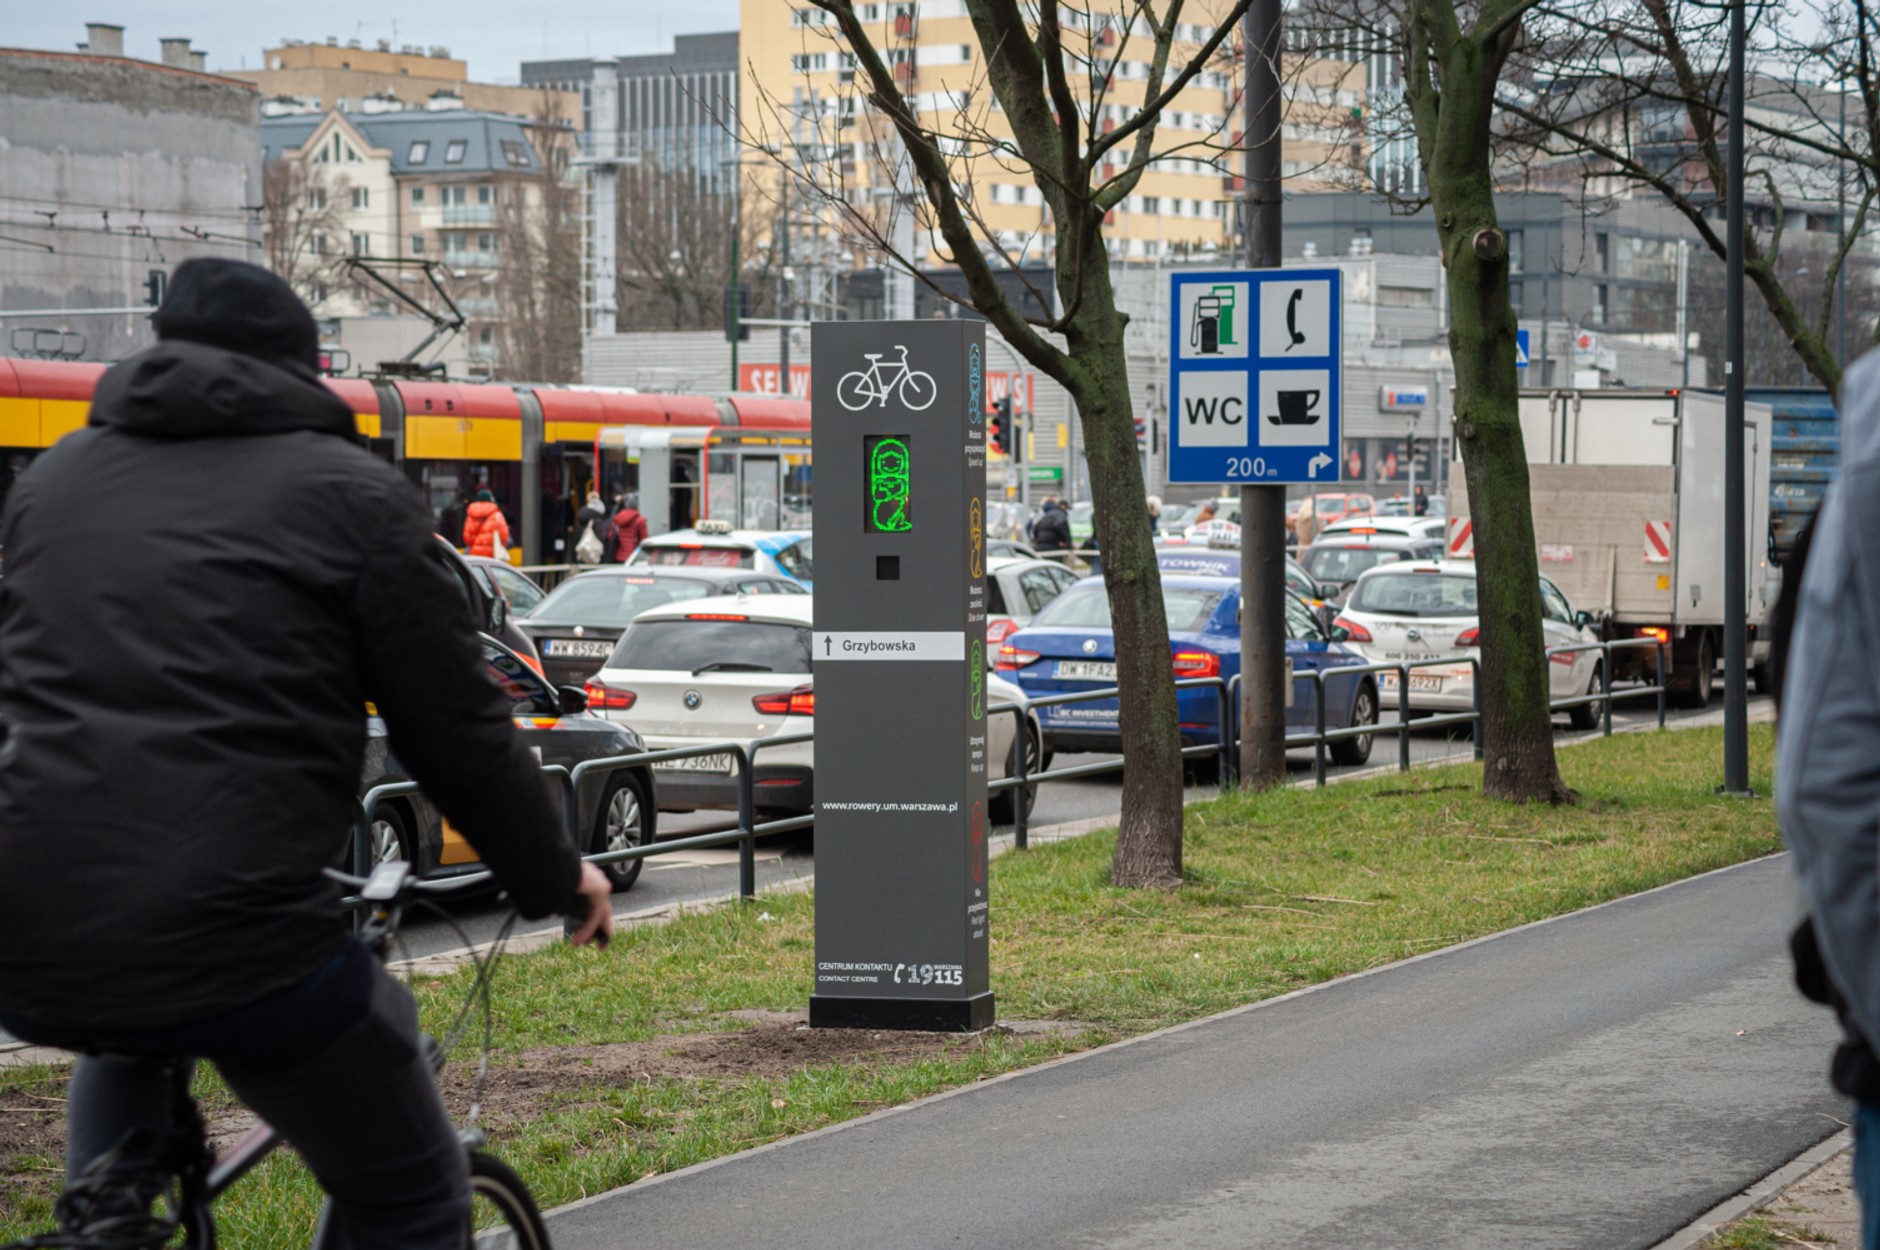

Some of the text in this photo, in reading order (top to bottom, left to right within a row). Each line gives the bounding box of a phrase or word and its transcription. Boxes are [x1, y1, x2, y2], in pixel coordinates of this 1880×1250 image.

[1184, 397, 1243, 426] WC
[842, 639, 916, 654] Grzybowska
[822, 801, 958, 814] www.rowery.um.warszawa.pl
[818, 962, 893, 971] CENTRUM KONTAKTU
[818, 975, 850, 983] CONTACT
